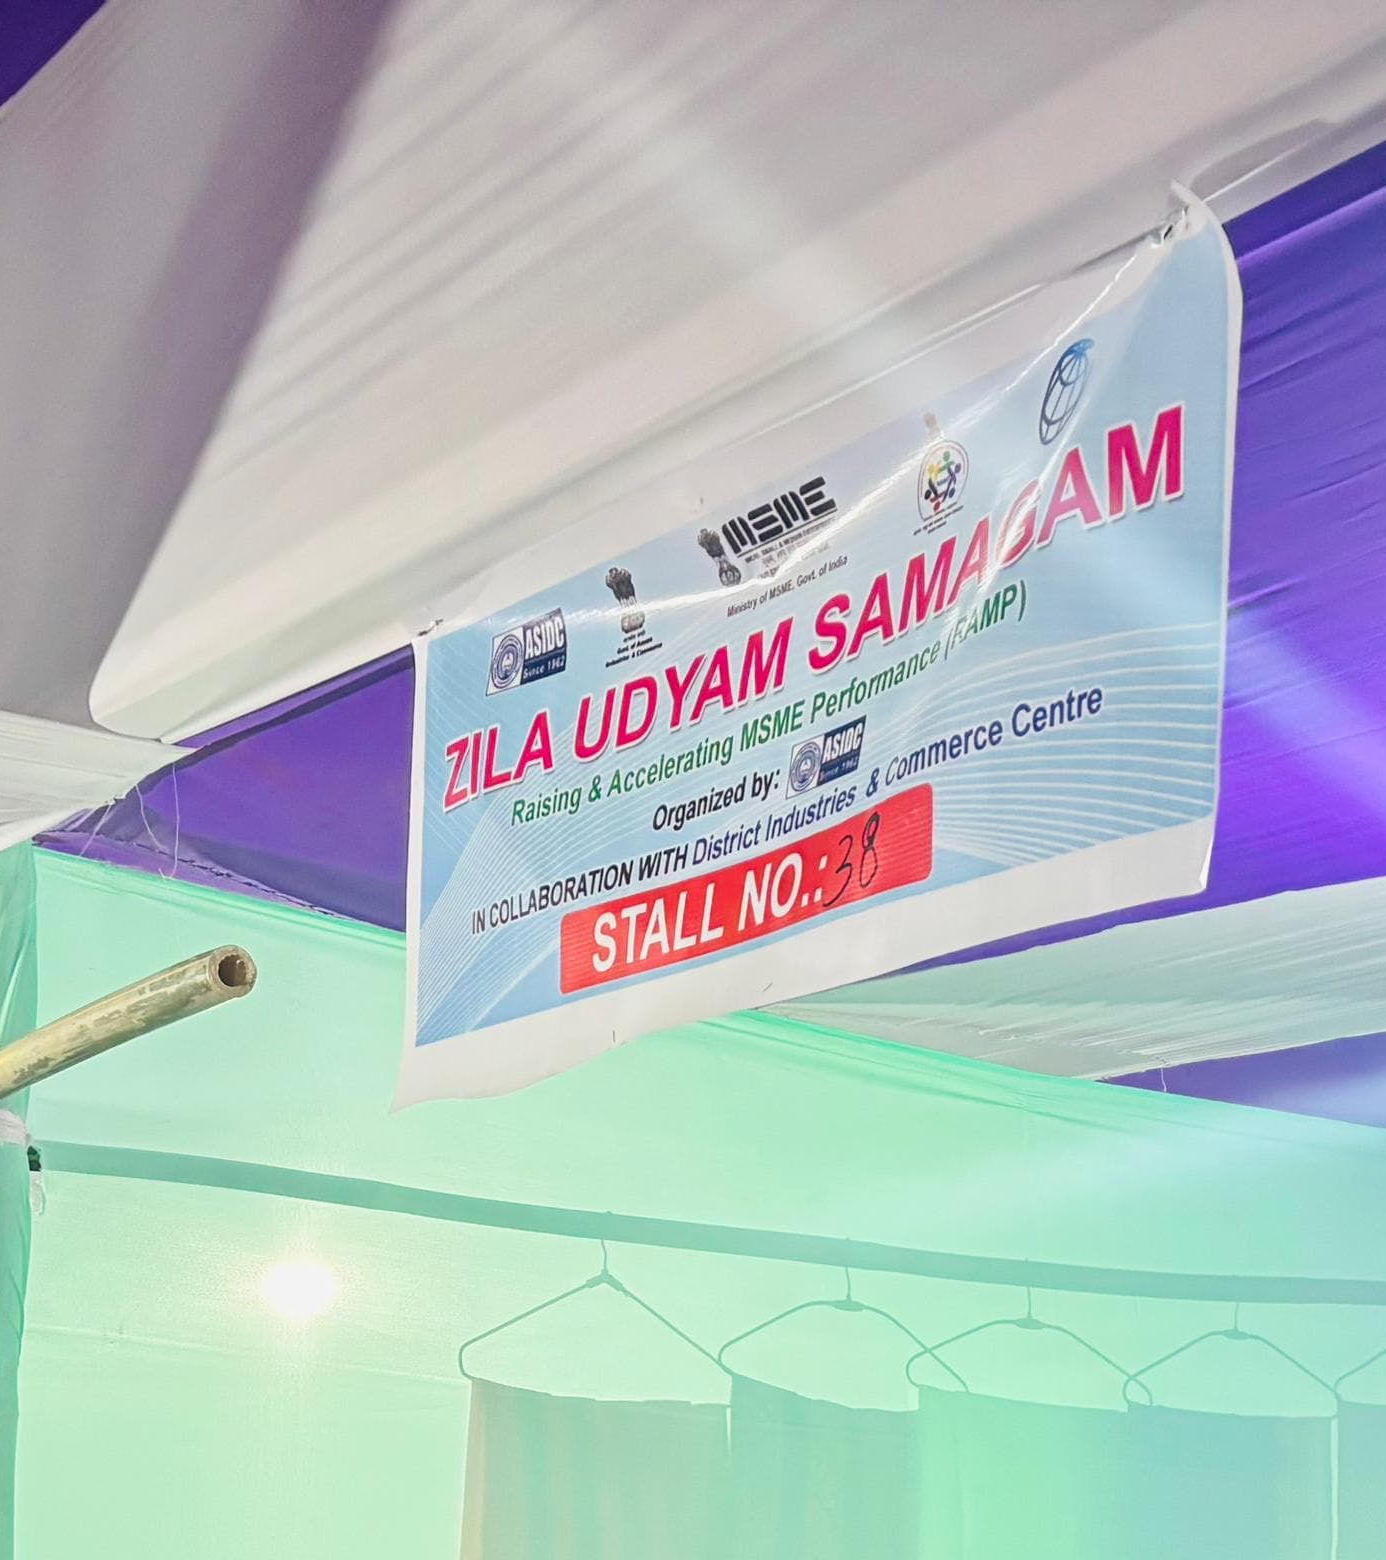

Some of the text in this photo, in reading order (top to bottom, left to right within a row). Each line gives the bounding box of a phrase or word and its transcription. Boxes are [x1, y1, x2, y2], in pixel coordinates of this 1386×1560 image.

[721, 476, 837, 554] MSME
[444, 404, 1182, 808] ZILA UDYAM SAMAGAM
[727, 596, 757, 617] Ministry
[759, 591, 769, 605] of
[819, 563, 828, 578] of
[828, 555, 848, 572] India
[523, 665, 545, 680] Since
[525, 615, 564, 660] ASIDC
[511, 785, 582, 826] Raising
[588, 775, 601, 801] &
[607, 735, 734, 797] Accelerating
[739, 700, 805, 752] MSME
[810, 639, 941, 723] Performance
[822, 722, 863, 764] ASIDC
[472, 688, 1103, 934] IN COLLABORATION WITH District Industries & Commerce Centre
[653, 769, 781, 830] Organized by:
[592, 882, 724, 972] STALL
